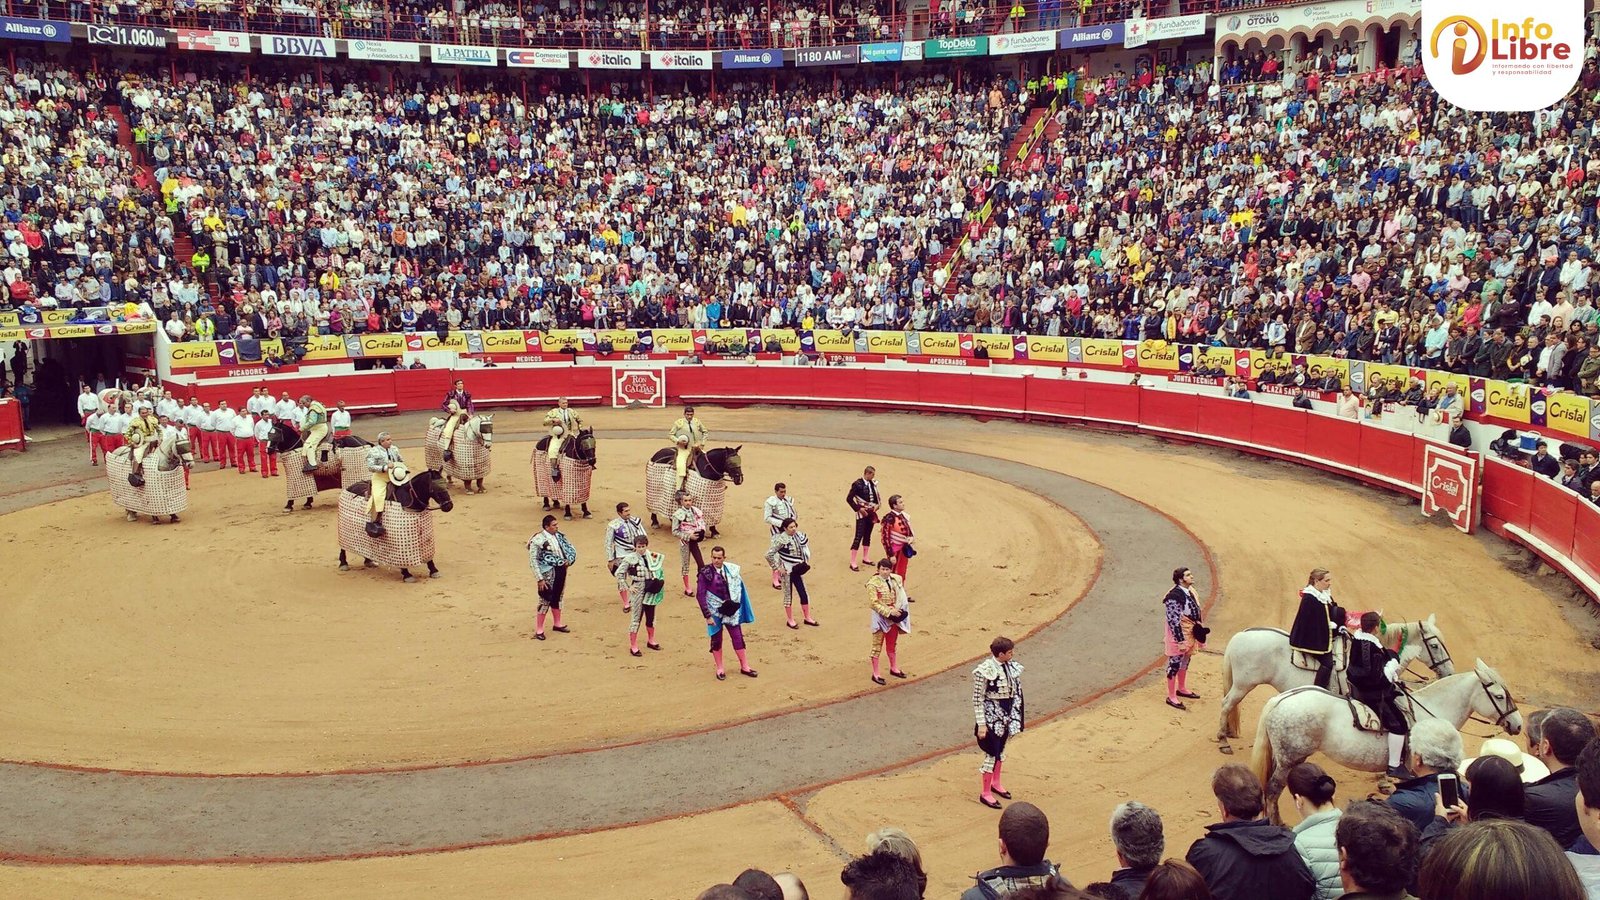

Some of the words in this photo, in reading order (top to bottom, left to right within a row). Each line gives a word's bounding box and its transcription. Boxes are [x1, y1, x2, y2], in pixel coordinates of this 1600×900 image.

[5, 22, 42, 34] Allianz
[1158, 18, 1200, 31] fundadores
[120, 27, 155, 47] 1.060
[155, 36, 166, 48] AM
[1011, 35, 1050, 46] fundadores
[1072, 32, 1100, 42] Allianz
[272, 36, 328, 56] BBVA
[938, 38, 976, 50] TopDeko
[437, 48, 451, 57] LA
[453, 48, 491, 59] PATRIA
[535, 51, 568, 59] Comercial
[734, 55, 761, 63] Allianz
[798, 52, 821, 63] 1180
[824, 50, 842, 61] AM
[602, 54, 632, 66] italia
[674, 55, 703, 66] italia
[57, 327, 87, 335] Cristal
[124, 324, 151, 332] Cristal
[365, 339, 402, 350] Cristal
[486, 336, 521, 346] Cristal
[818, 335, 850, 345] Cristal
[870, 336, 903, 346] Cristal
[923, 337, 956, 348] Cristal
[304, 342, 341, 352] Cristal
[1031, 342, 1064, 353] Cristal
[1085, 345, 1119, 356] Cristal
[172, 348, 214, 359] Cristal
[1140, 349, 1175, 361] Cristal
[930, 358, 967, 366] APODERADOS
[228, 368, 268, 376] PICADORES
[1173, 374, 1191, 383] JUNTA
[1193, 377, 1217, 386] TECNICA
[625, 385, 654, 394] CALDAS
[1262, 384, 1282, 394] PLAZA
[1489, 390, 1527, 410] Cristal
[1550, 402, 1586, 423] Cristal
[1432, 476, 1459, 496] Cristal
